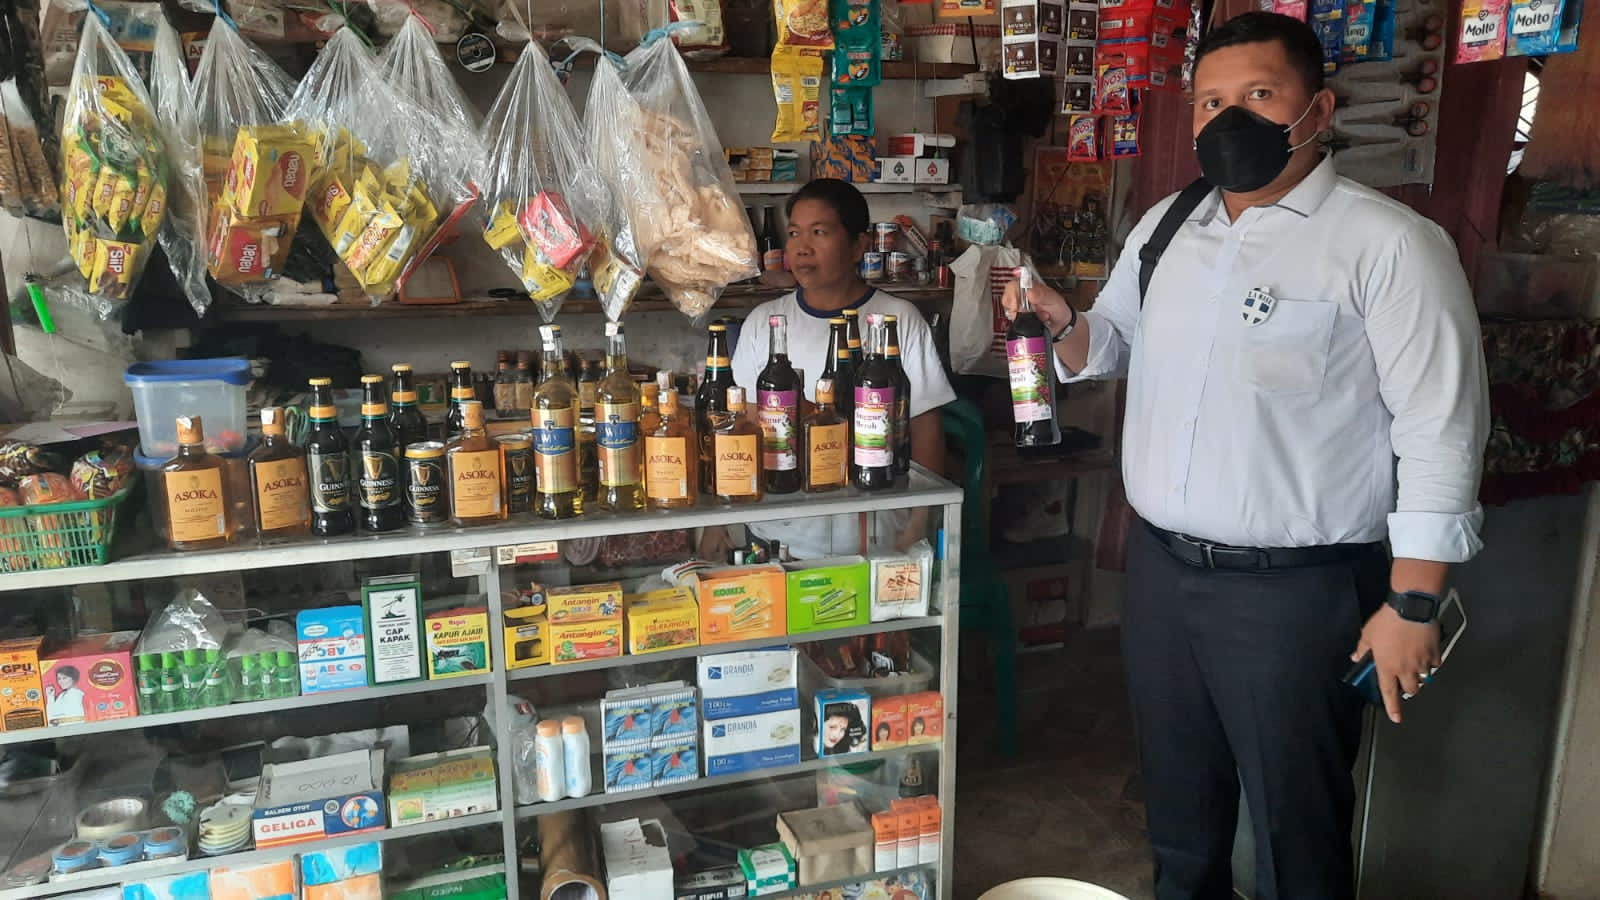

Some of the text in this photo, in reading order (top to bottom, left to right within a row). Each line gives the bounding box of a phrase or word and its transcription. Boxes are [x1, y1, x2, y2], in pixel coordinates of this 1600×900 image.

[1515, 10, 1550, 27] Molto
[1465, 22, 1496, 37] Molto
[110, 250, 124, 274] SiiP
[238, 243, 259, 273] nabati
[814, 441, 843, 452] ASOKA
[648, 455, 682, 466] ASOKA
[719, 452, 753, 462] ASOKA
[457, 470, 496, 481] ASOKA
[263, 477, 302, 492] ASOKA
[359, 478, 394, 487] GUINNESS
[174, 488, 218, 502] ASOKA
[713, 586, 746, 597] KOMIX
[561, 598, 600, 608] Antangin
[385, 627, 404, 636] CAP
[433, 627, 484, 640] KAPUR AJAIB
[560, 629, 602, 640] Antangin
[380, 634, 411, 644] KAPAK
[1, 662, 32, 674] GPU
[320, 663, 345, 673] ABC
[723, 663, 754, 675] GRANDIA
[727, 719, 758, 732] GRANDIA
[264, 804, 310, 816] BALSEM OTOT
[260, 817, 316, 833] GELIGA
